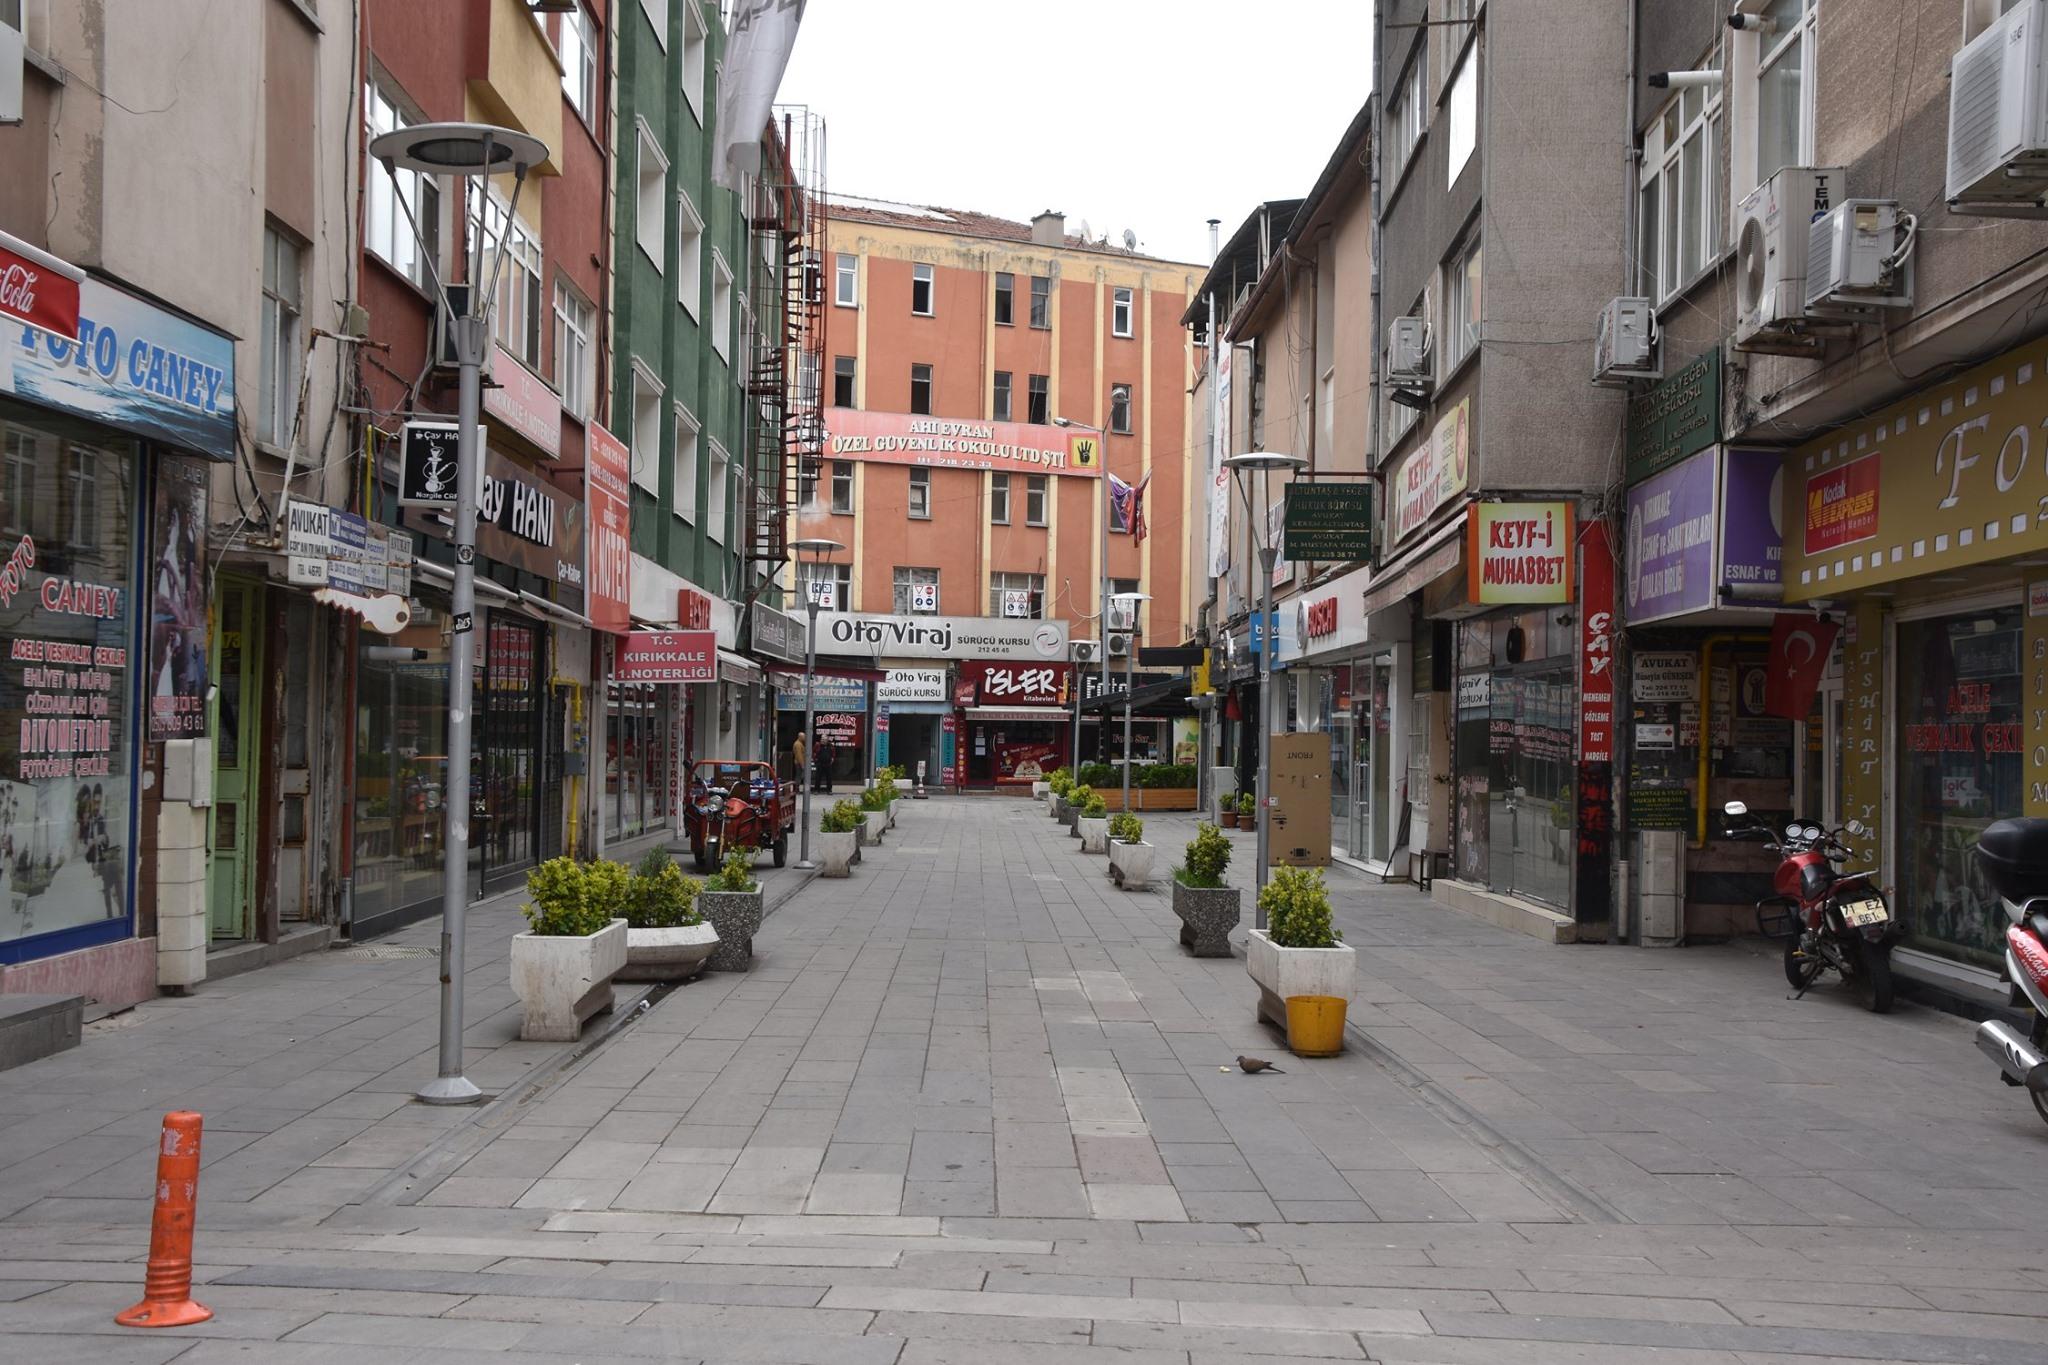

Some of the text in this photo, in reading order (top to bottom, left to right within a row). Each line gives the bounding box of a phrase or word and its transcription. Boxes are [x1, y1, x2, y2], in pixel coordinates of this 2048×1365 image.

[128, 338, 223, 413] CANEY
[1679, 359, 1710, 389] YEĞEN
[1664, 383, 1702, 415] BÜROSU
[424, 431, 442, 440] Çay
[941, 423, 994, 440] EVRAN
[832, 434, 873, 454] ÖZEL
[959, 441, 1010, 460] OKULU
[1011, 446, 1040, 465] LTD
[1040, 450, 1066, 470] ŞTİ
[1935, 414, 2048, 510] FO
[416, 492, 442, 500] Nargile
[1823, 480, 1846, 505] Kodak
[512, 480, 553, 547] HANI
[1822, 490, 1875, 526] EXPRESS
[290, 508, 328, 537] AVUKAT
[1489, 511, 1553, 548] KEYF-İ
[598, 524, 628, 605] NOTER
[1483, 556, 1565, 585] MUHABBET
[1725, 564, 1777, 581] ESNAF ve
[41, 577, 120, 619] CANEY
[1308, 597, 1338, 638] BOSCH
[651, 635, 678, 646] T.C.
[831, 619, 952, 650] Oto Viraj
[957, 634, 1031, 646] SÜRÜCÜ KURSU
[1587, 612, 1611, 675] ÇAY
[11, 639, 43, 661] ACELE
[623, 652, 706, 663] KIRIKKALE
[619, 667, 713, 679] 1.NOTERLİĞİ
[1641, 658, 1688, 668] AVUKAT
[23, 665, 64, 688] EHLİYET
[65, 673, 78, 689] ve
[895, 672, 941, 685] Oto Viraj
[985, 667, 1057, 696] İŞLER
[879, 687, 941, 697] SÜRÜCÜ KURSU
[1945, 682, 1991, 714] ACELE
[815, 713, 857, 727] LOZAN
[1584, 711, 1609, 723] GÖZLEME
[20, 719, 111, 753] BİYOMETRİK
[1590, 732, 1603, 742] TOST
[20, 754, 73, 778] FOTOĞRAF
[1287, 751, 1314, 760] FRONT
[1842, 900, 1882, 916] 71 EZ
